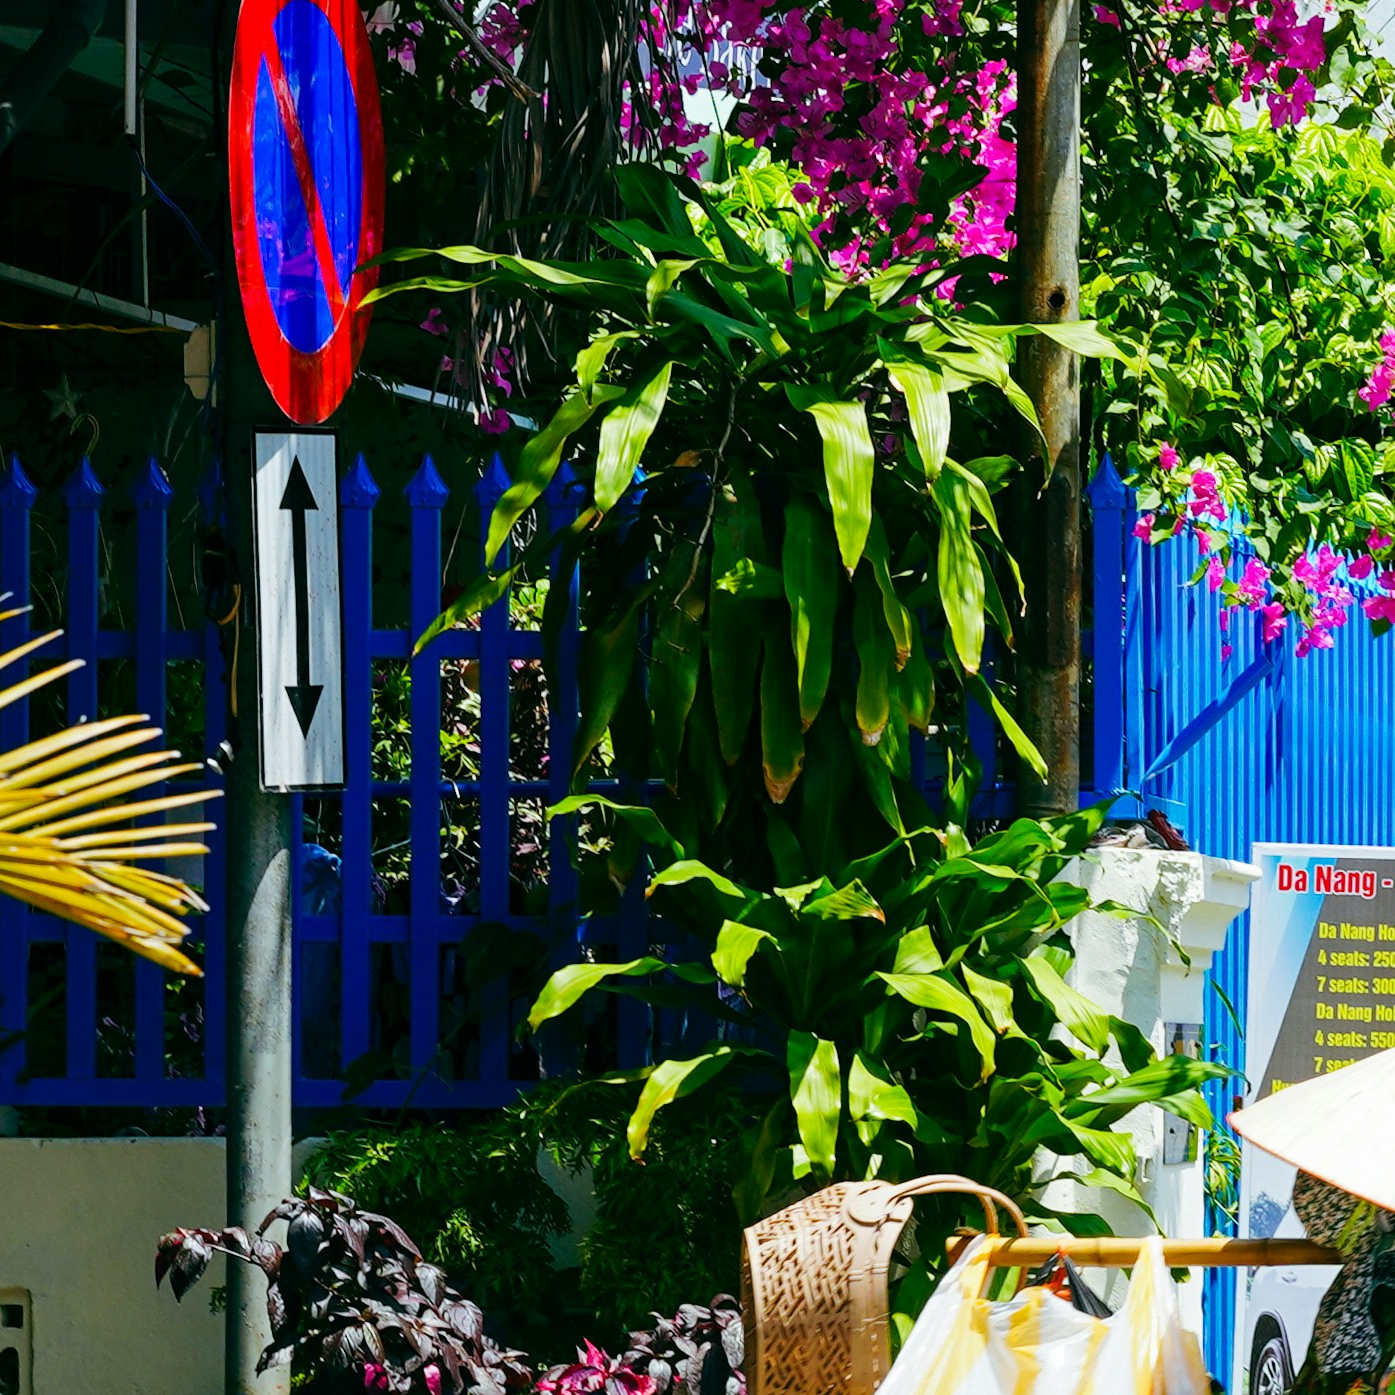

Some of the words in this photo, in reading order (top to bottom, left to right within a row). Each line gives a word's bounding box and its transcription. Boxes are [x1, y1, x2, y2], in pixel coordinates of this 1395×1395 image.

[1277, 864, 1306, 892] Da
[1315, 866, 1375, 898] Nang
[1319, 923, 1336, 939] Da
[1340, 923, 1375, 942] Nang
[1317, 950, 1327, 965] 4
[1330, 951, 1370, 967] seats:
[1317, 976, 1326, 992] 7
[1329, 977, 1369, 994] seats:
[1316, 1003, 1333, 1019] Da
[1337, 1004, 1372, 1023] Nang
[1314, 1030, 1324, 1046] 4
[1327, 1031, 1367, 1047] seats:
[1314, 1057, 1323, 1072] 7
